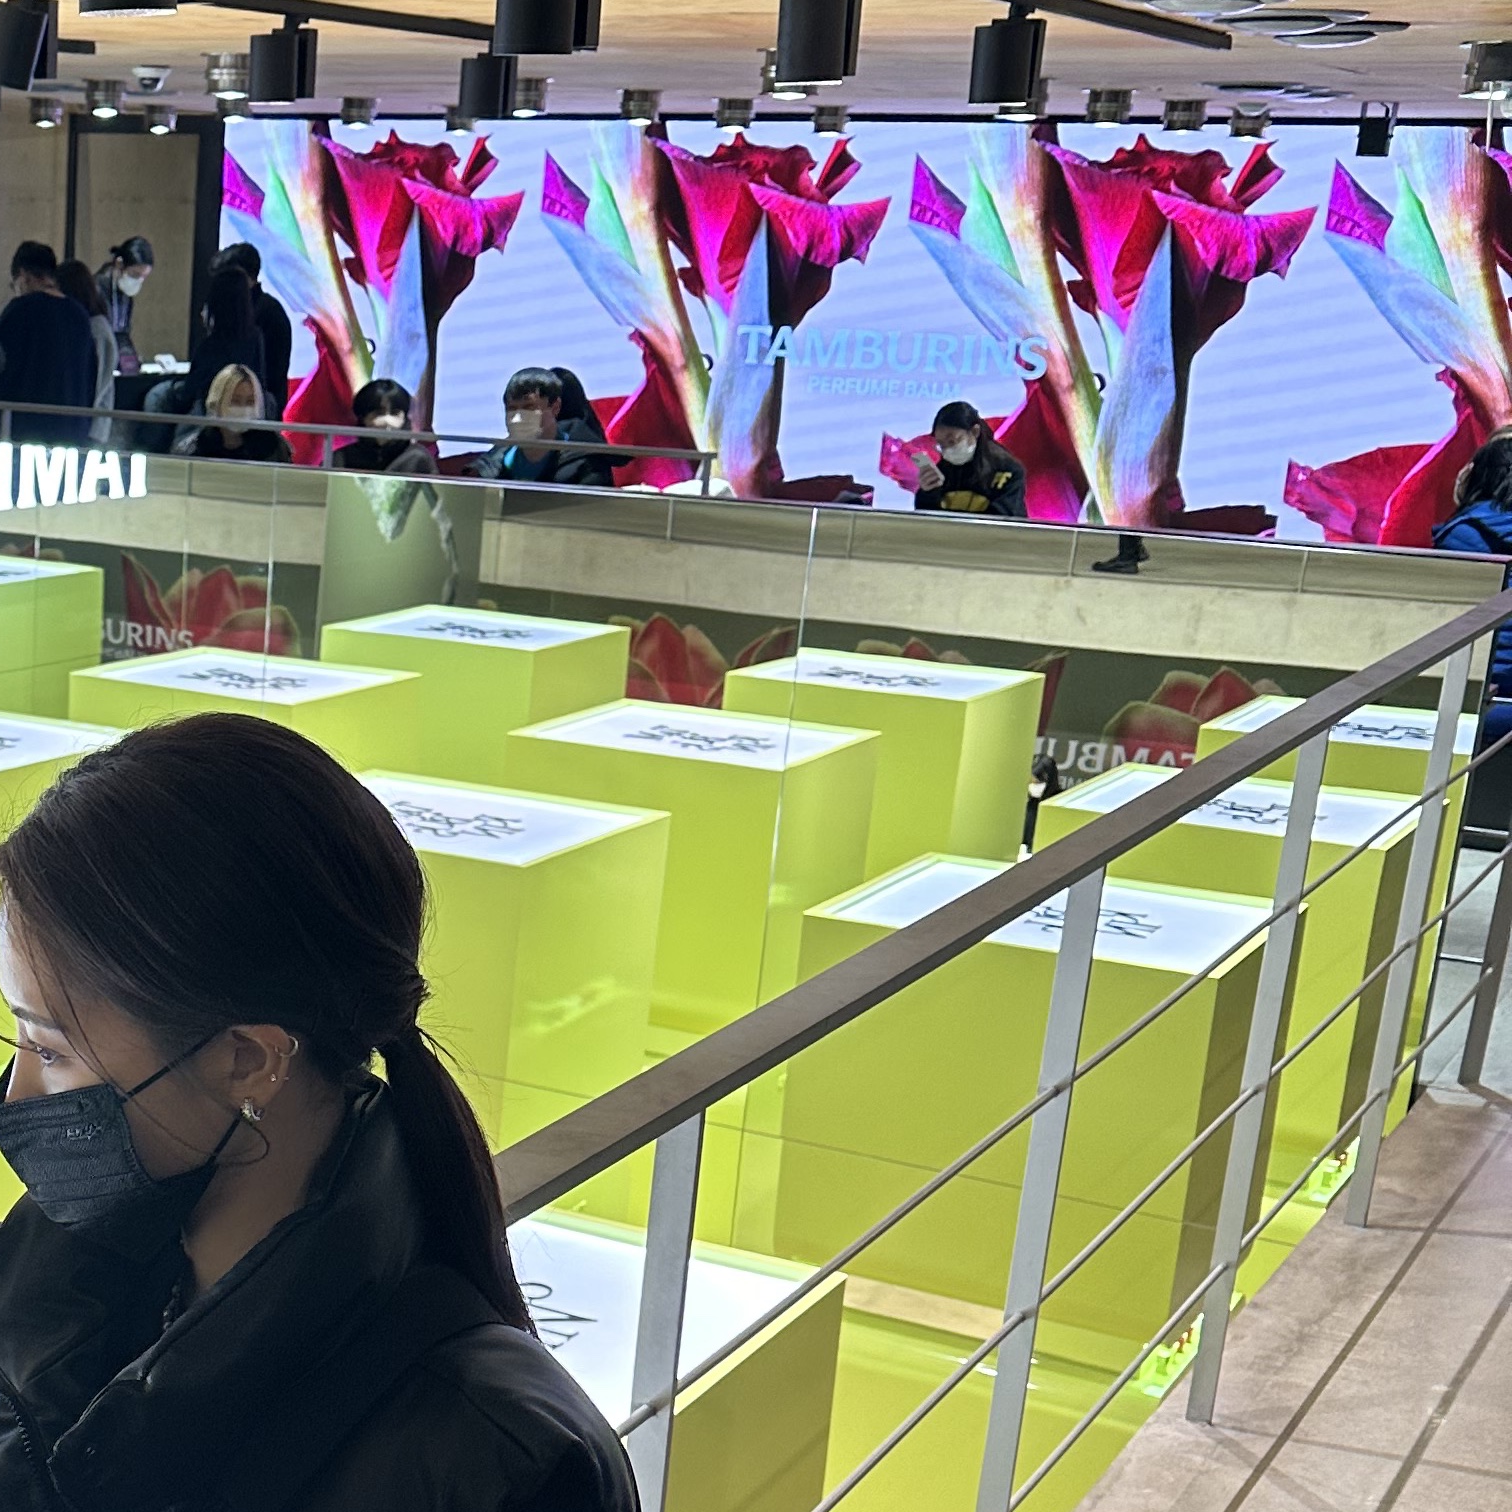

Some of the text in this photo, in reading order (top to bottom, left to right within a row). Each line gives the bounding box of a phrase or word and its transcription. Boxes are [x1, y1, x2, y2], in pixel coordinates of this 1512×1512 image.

[737, 324, 1048, 380] TAMBURINS
[807, 375, 962, 399] PERFUME BALM
